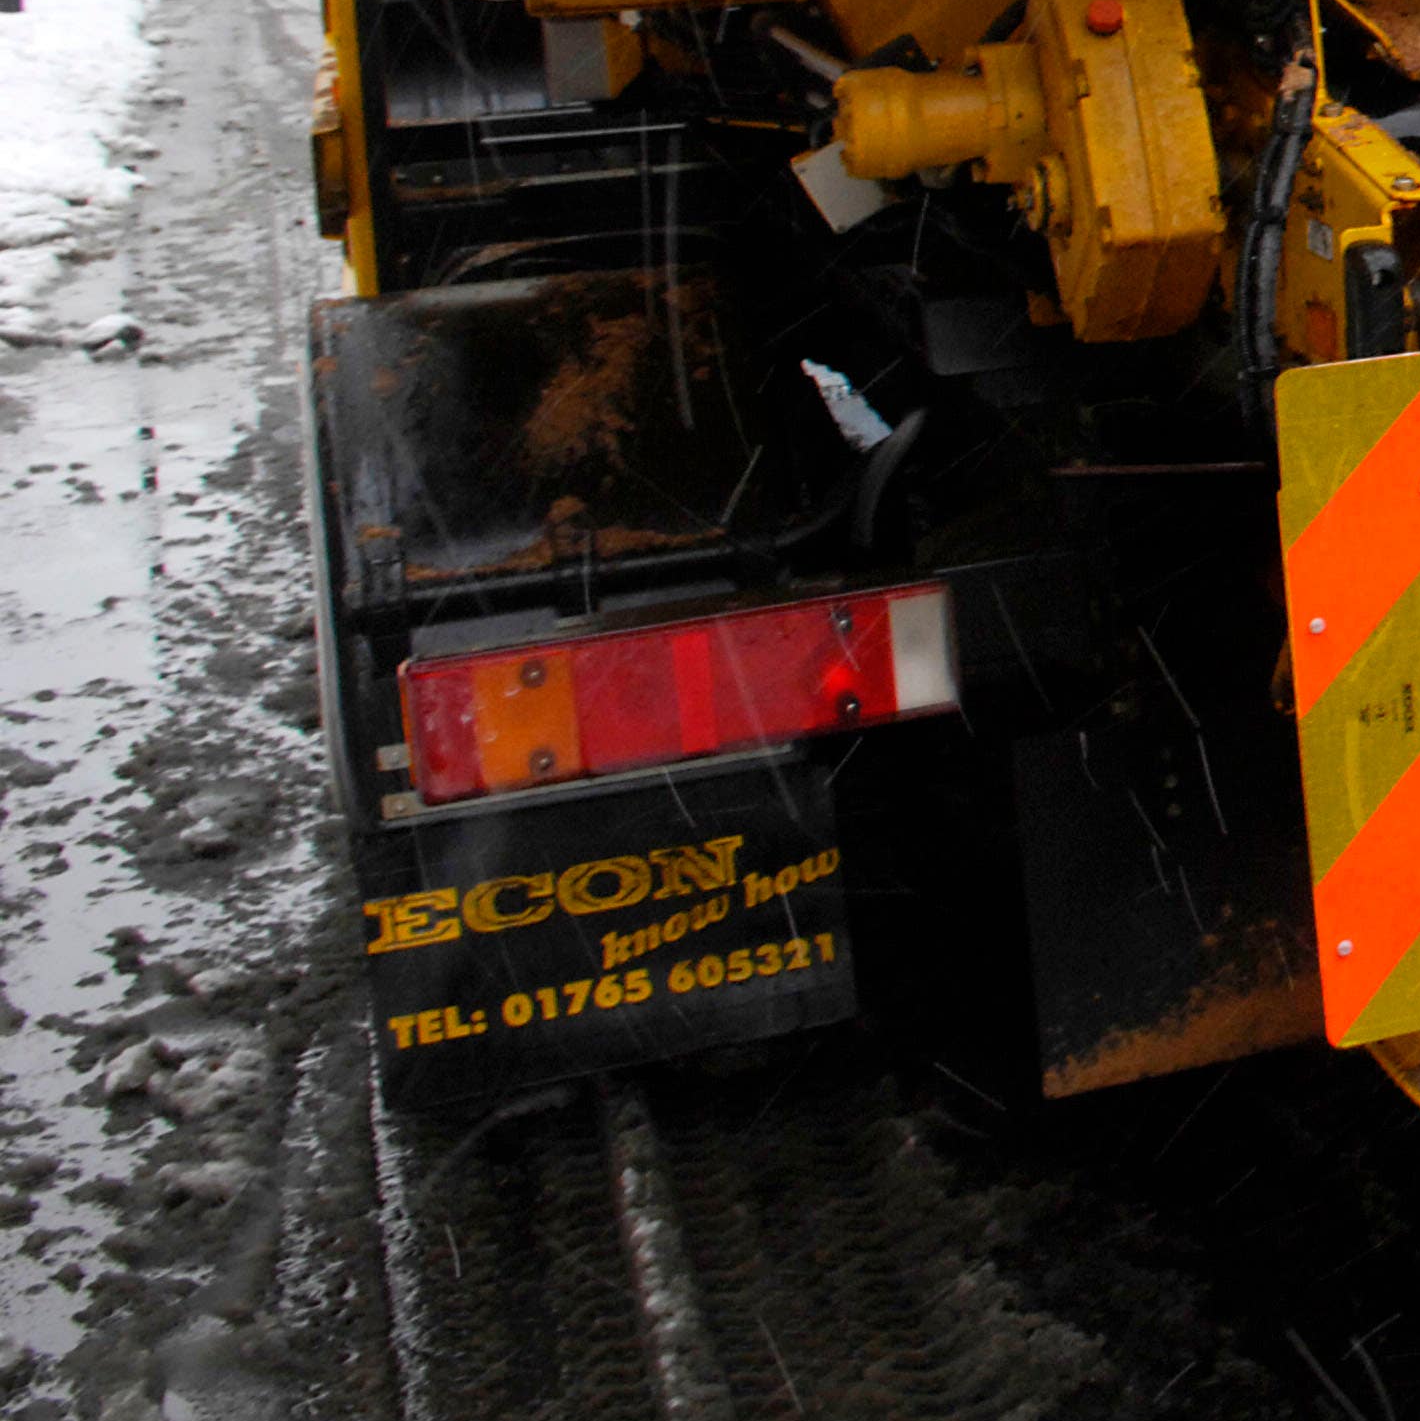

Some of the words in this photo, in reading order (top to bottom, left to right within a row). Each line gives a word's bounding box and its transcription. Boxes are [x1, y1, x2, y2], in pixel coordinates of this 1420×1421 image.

[363, 834, 744, 956] ECON
[600, 893, 731, 971] know
[742, 846, 841, 908] how
[387, 1004, 489, 1051] TEL:
[501, 968, 654, 1028] 01765
[666, 932, 836, 995] 605321
